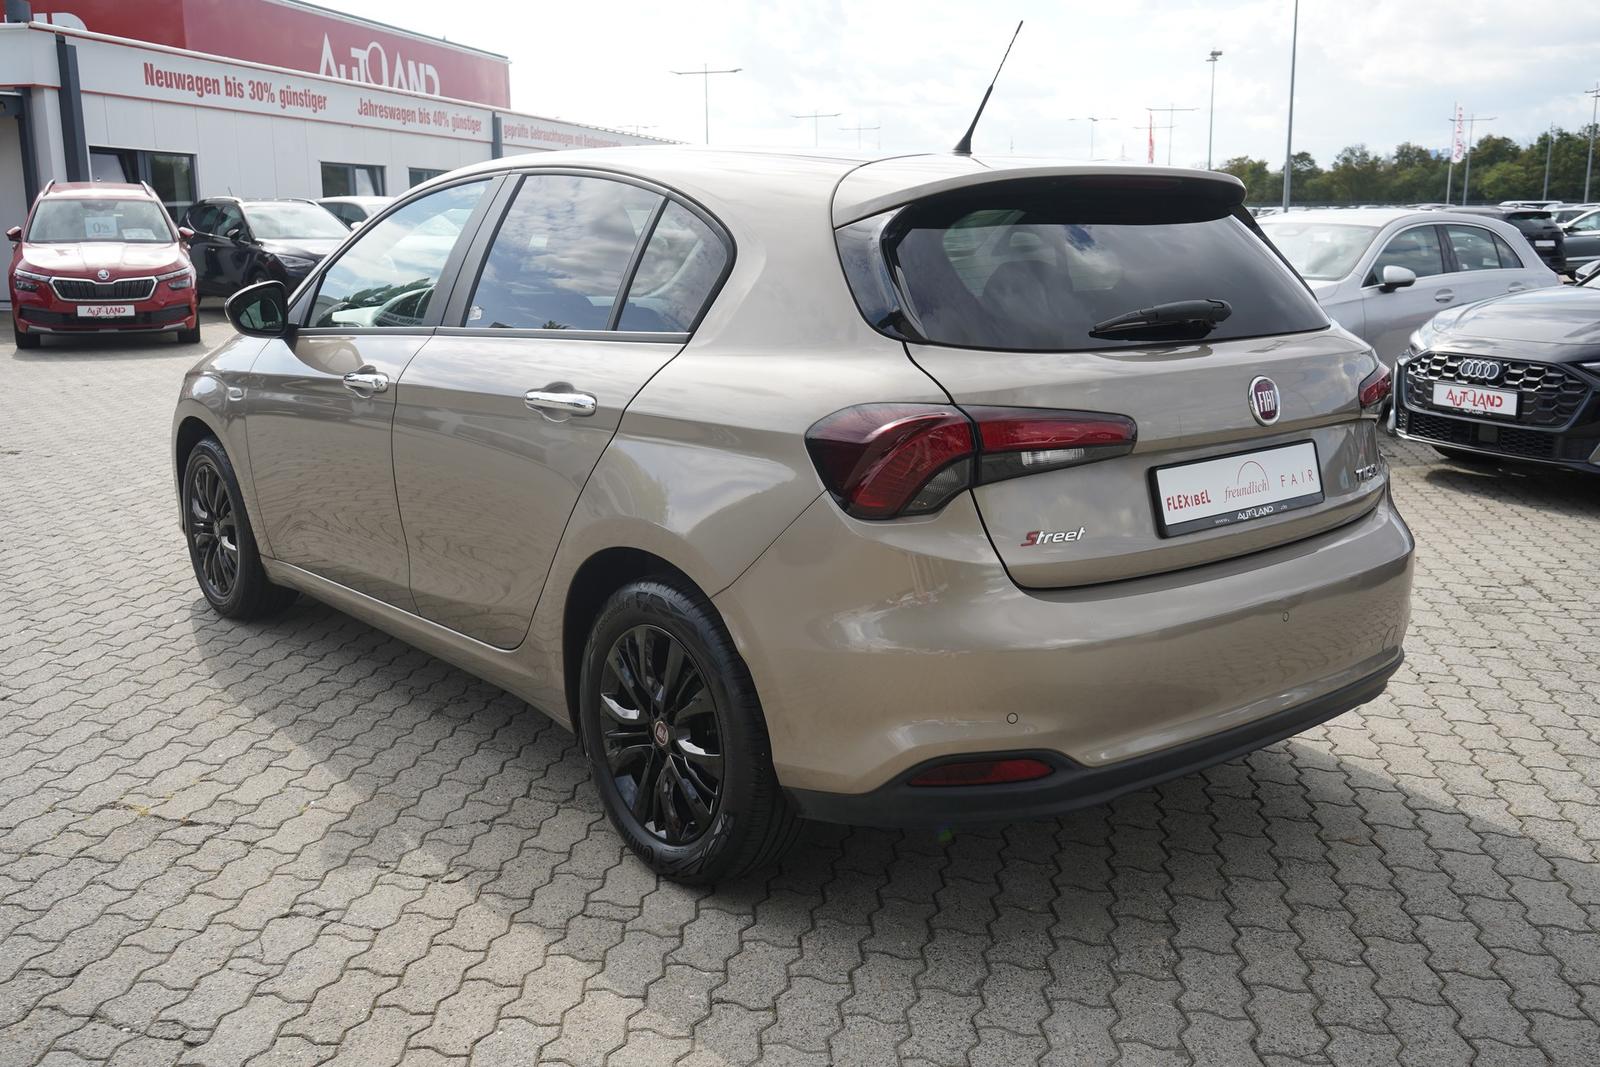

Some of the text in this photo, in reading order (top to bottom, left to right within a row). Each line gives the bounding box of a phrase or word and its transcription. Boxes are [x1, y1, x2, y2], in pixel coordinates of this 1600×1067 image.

[143, 62, 328, 113] Neuwagen bis 30% günstiger
[357, 98, 482, 134] Jahreswagen bis 40% günstiger
[1257, 390, 1275, 412] FIAT
[1446, 388, 1503, 410] AUTOLAND
[1166, 489, 1212, 512] FLEXIBEL
[1224, 479, 1268, 503] freundlich
[1237, 505, 1274, 520] AUTOLAND
[1020, 527, 1086, 547] Street
